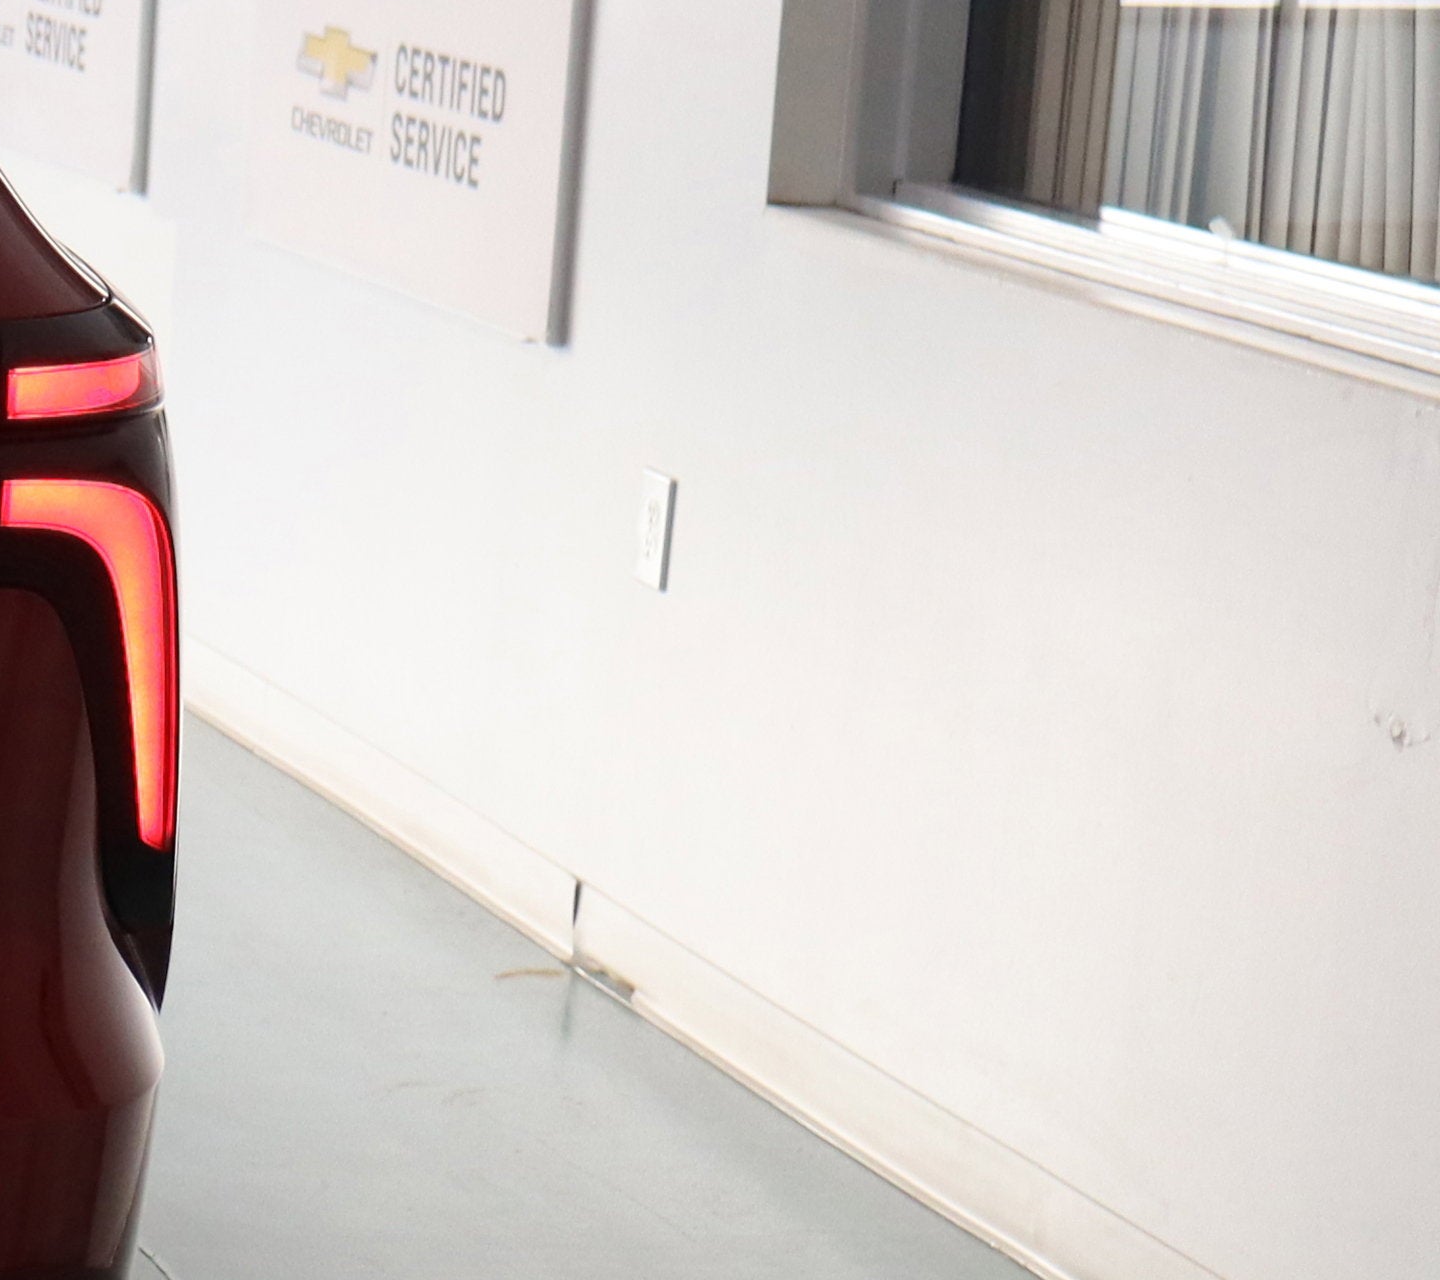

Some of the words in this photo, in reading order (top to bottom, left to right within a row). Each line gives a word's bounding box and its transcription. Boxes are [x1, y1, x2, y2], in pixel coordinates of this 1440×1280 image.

[26, 10, 87, 71] SERVICE
[395, 42, 507, 123] CERTIFIED
[291, 105, 374, 154] CHEVROLET
[390, 110, 483, 189] SERVICE
